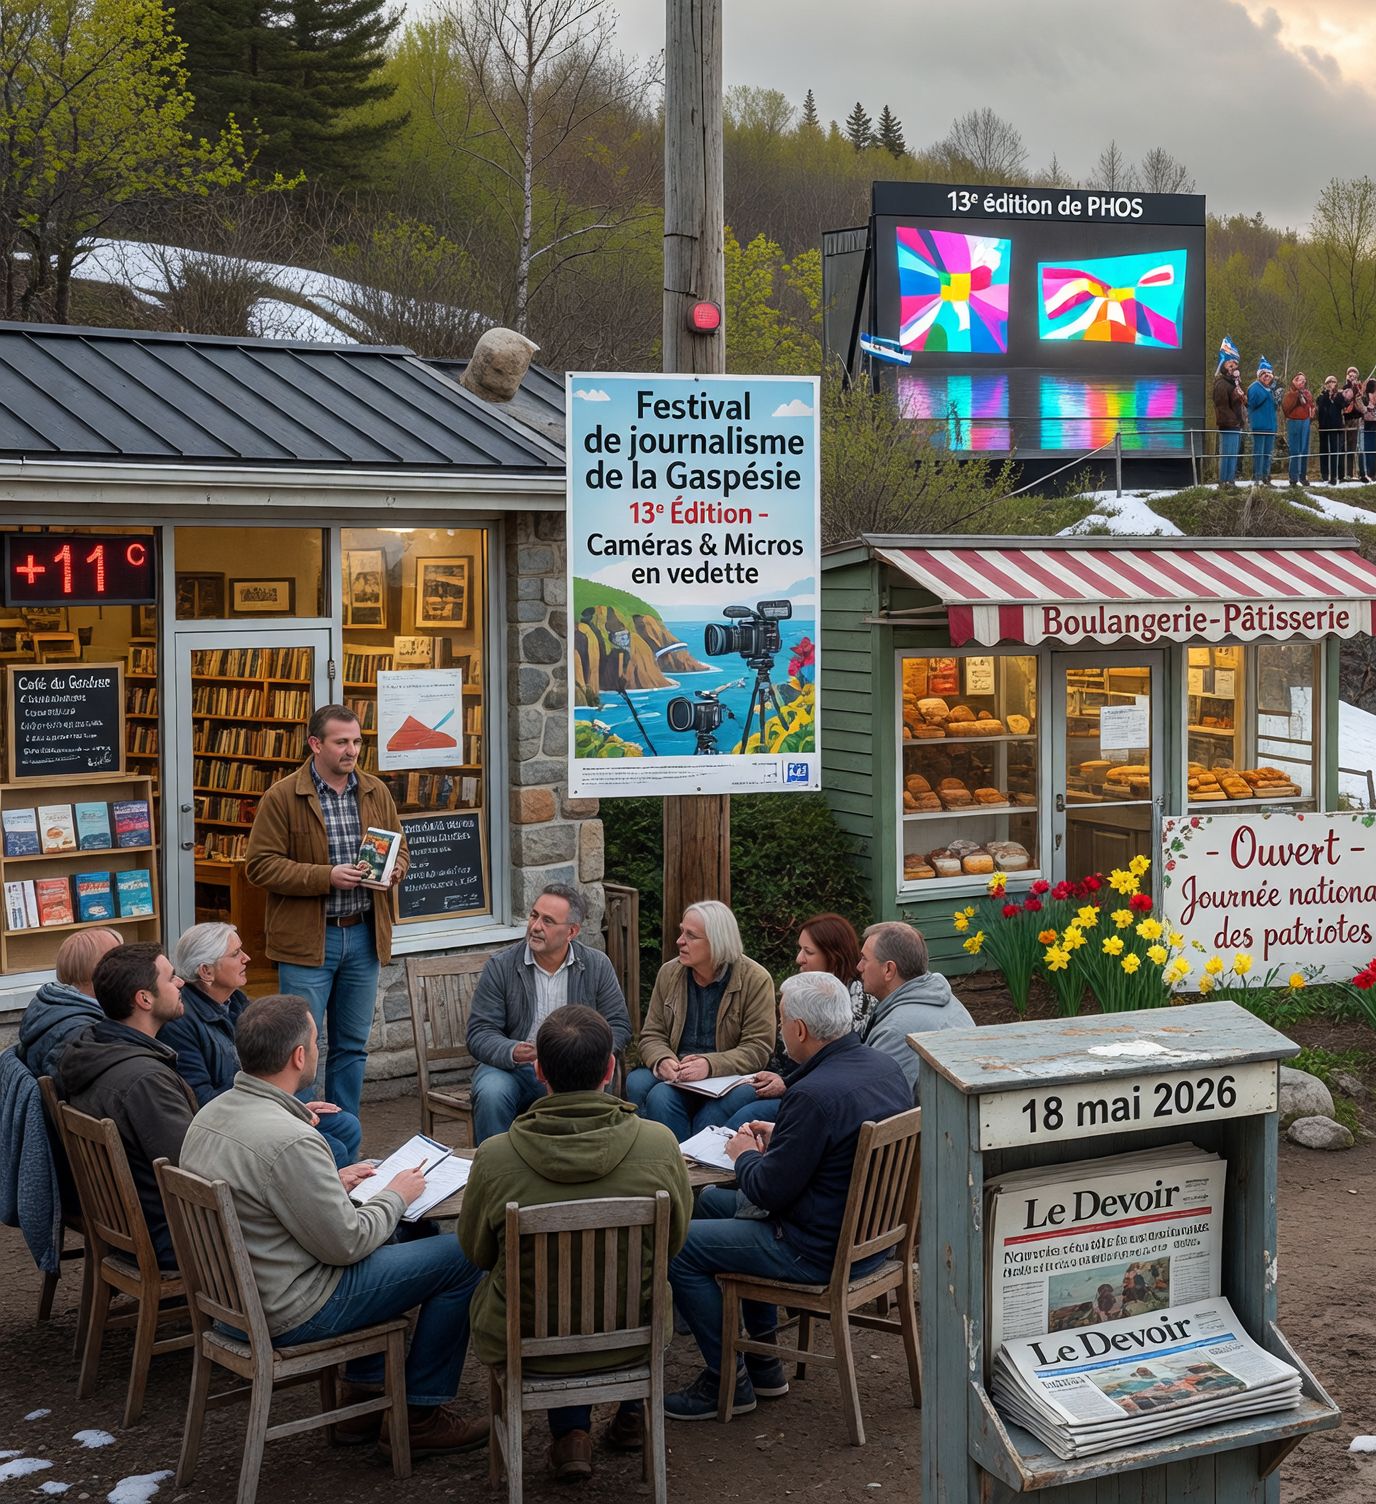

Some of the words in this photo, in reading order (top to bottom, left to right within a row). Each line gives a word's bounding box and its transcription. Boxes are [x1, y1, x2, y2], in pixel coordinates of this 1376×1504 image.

[983, 193, 1053, 215] édition
[1058, 195, 1082, 216] de
[1088, 196, 1144, 218] PHOS
[637, 390, 751, 421] Festival
[584, 424, 621, 454] de
[627, 425, 804, 461] journalisme
[585, 460, 623, 490] de
[632, 460, 657, 490] la
[666, 460, 801, 498] Gaspésie
[671, 495, 752, 524] Édition
[587, 533, 692, 556] Caméras
[700, 533, 717, 556] &
[725, 533, 804, 556] Micros
[631, 566, 660, 584] en
[667, 561, 759, 584] vedette
[1042, 603, 1350, 642] Boulangerie-Pâtisserie
[1230, 825, 1341, 870] Ouvert
[1180, 875, 1282, 926] Journée
[1213, 915, 1253, 949] des
[1264, 914, 1373, 961] patriotes
[1022, 1096, 1064, 1133] 18
[1076, 1085, 1141, 1127] mai
[1153, 1075, 1237, 1118] 2026
[1023, 1198, 1066, 1230] Le
[1071, 1179, 1180, 1222] Devoir
[1027, 1342, 1079, 1366] Le
[1076, 1315, 1192, 1359] Devoir
